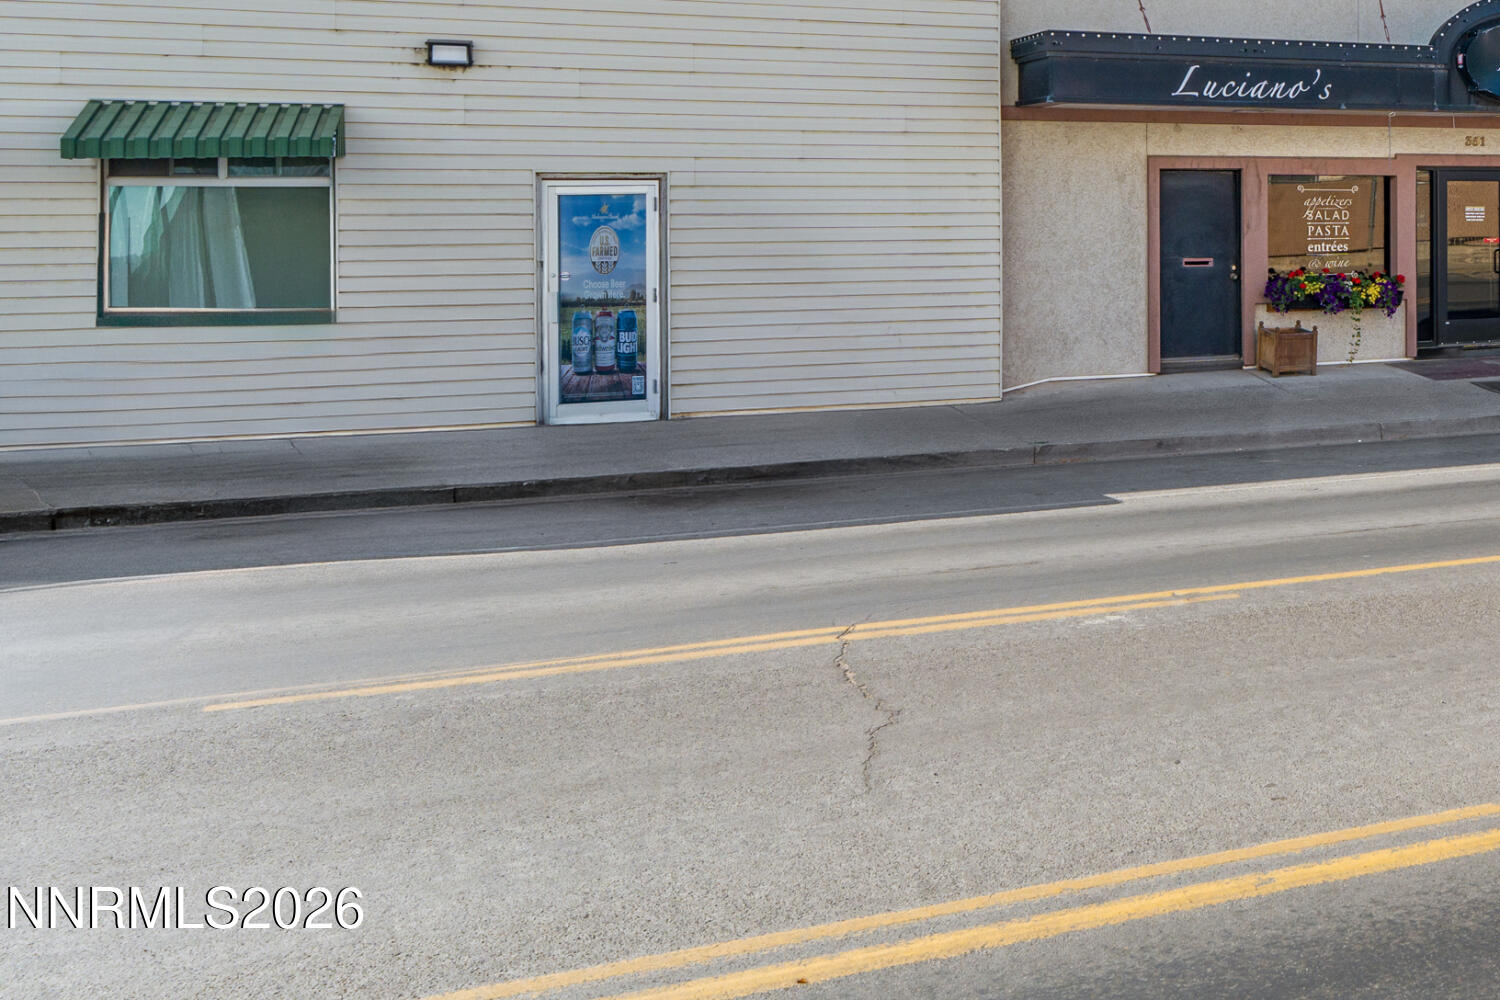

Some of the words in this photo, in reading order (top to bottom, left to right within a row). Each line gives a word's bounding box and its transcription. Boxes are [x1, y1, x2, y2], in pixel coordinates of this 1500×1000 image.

[1171, 64, 1332, 100] Luciano's
[1303, 195, 1353, 218] appetizers
[1306, 210, 1350, 221] SALAD
[1307, 225, 1350, 237] PASTA
[592, 245, 618, 257] FARMED
[1307, 240, 1349, 252] entrées
[1324, 256, 1351, 269] wine
[583, 279, 608, 289] Choose
[619, 331, 637, 342] BUD
